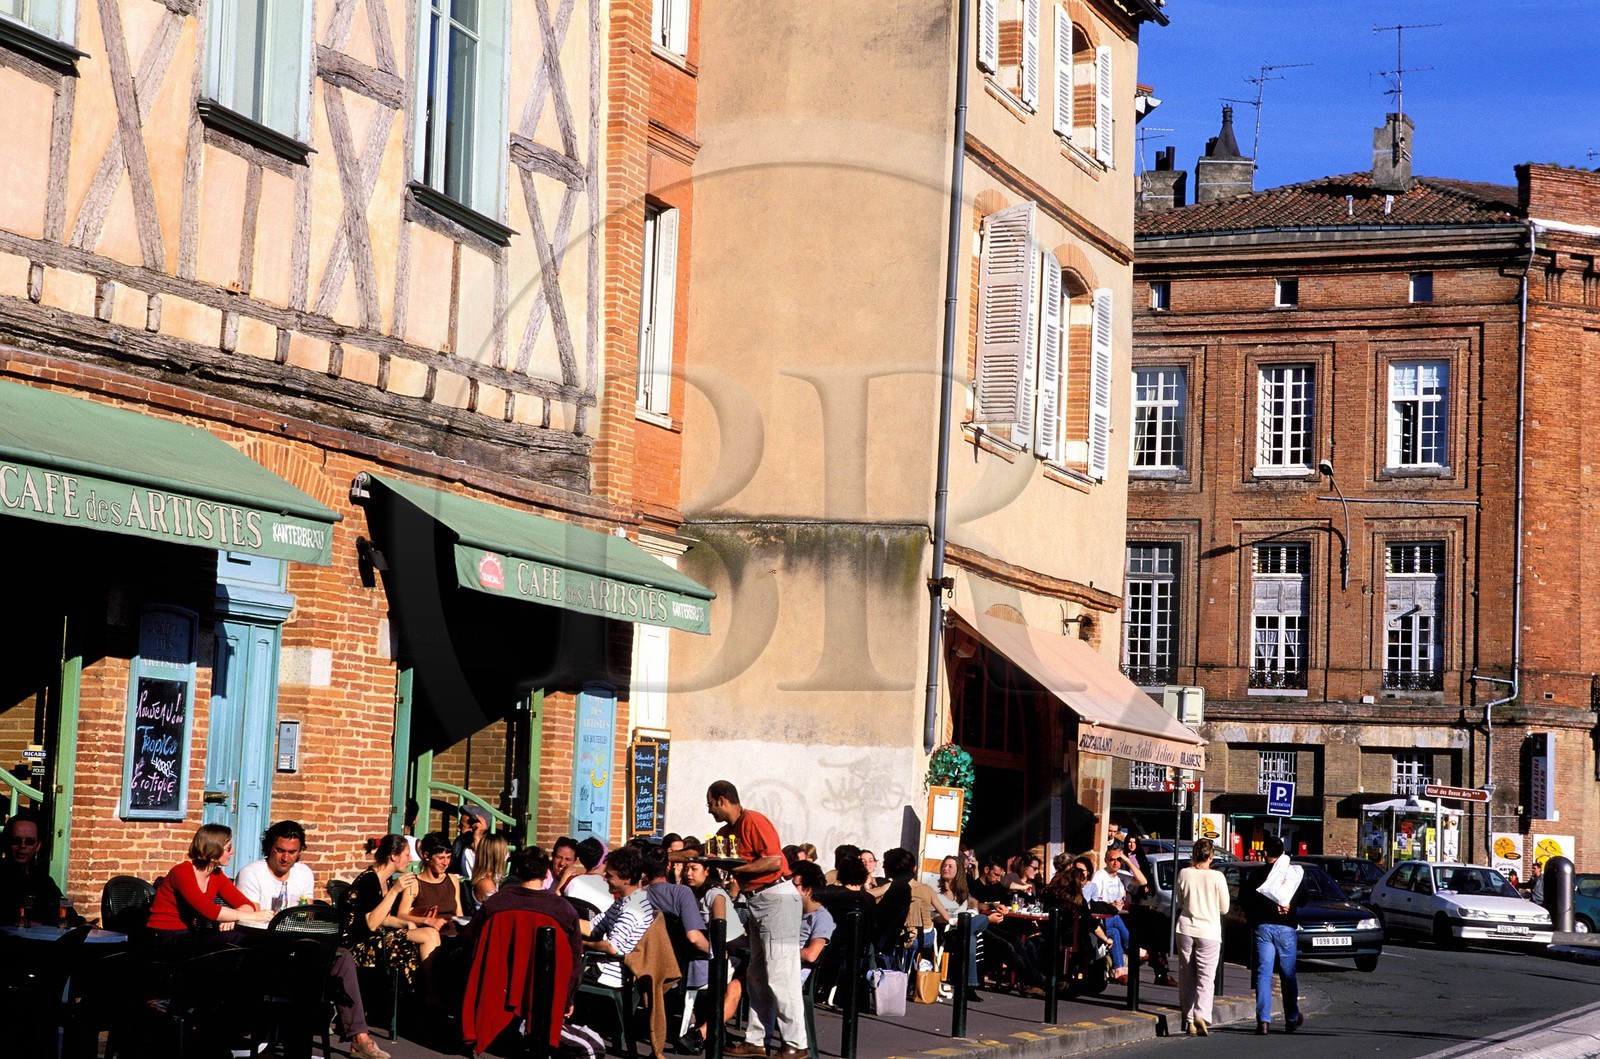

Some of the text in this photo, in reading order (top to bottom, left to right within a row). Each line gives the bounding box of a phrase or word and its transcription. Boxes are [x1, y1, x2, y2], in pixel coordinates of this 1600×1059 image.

[0, 464, 263, 549] CAFE des ARTISTES
[517, 561, 668, 622] CAFE des ARTISTES
[583, 718, 610, 729] ARTISTES
[1275, 786, 1287, 801] P
